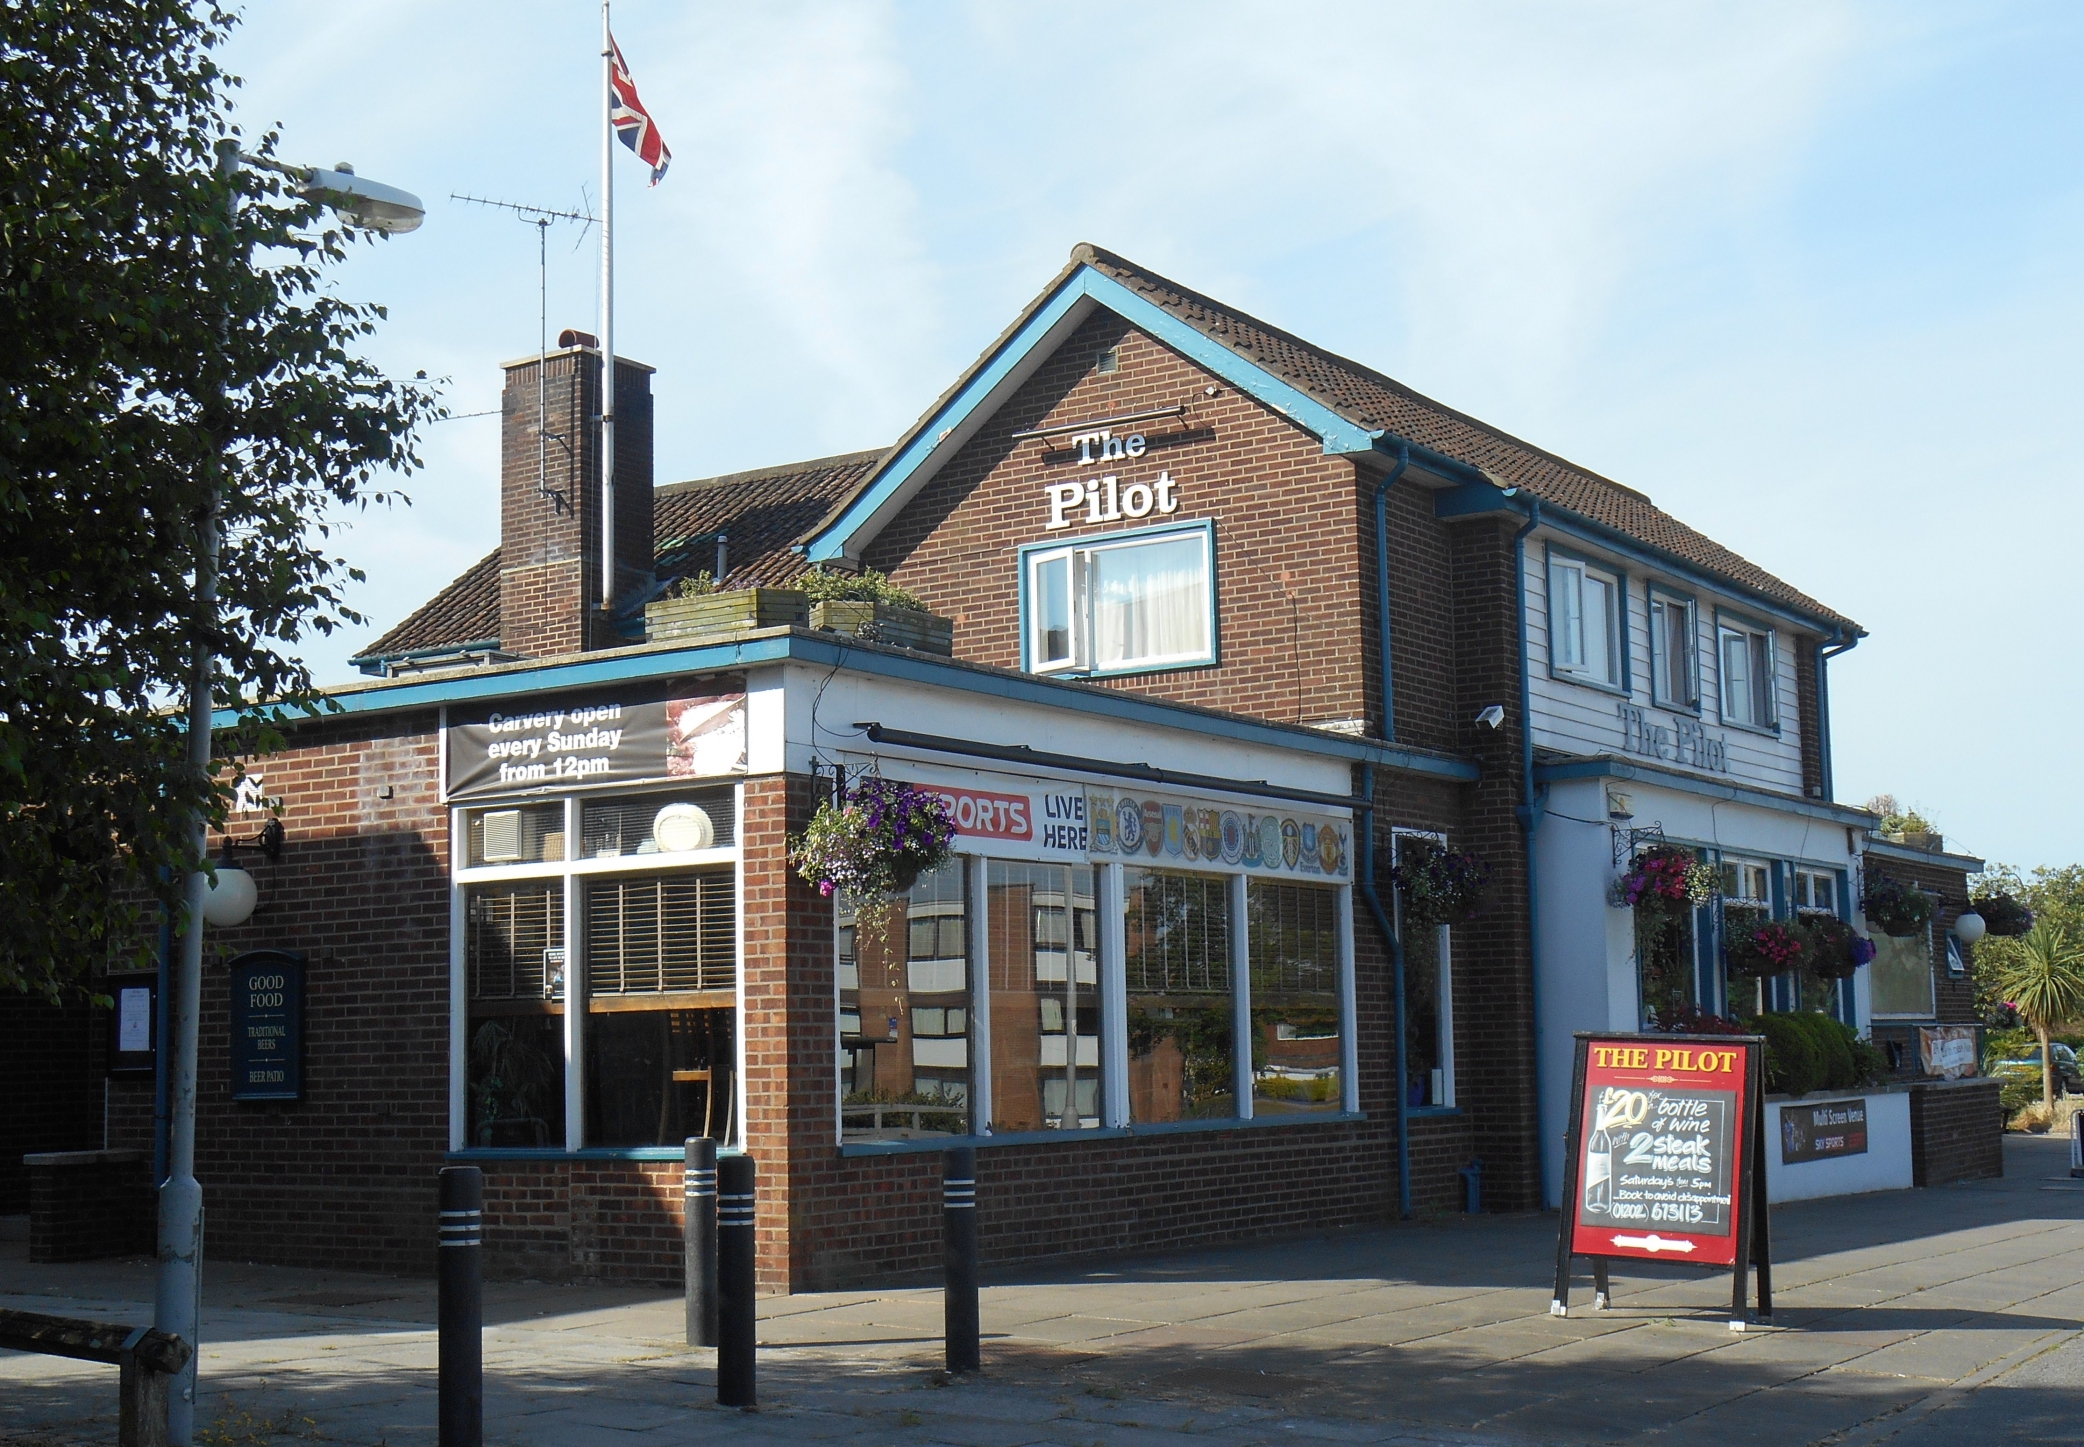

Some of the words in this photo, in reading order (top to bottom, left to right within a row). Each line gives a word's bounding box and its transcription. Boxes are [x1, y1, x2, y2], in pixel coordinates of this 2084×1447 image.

[1072, 430, 1146, 465] The
[1044, 471, 1178, 530] Pilot
[488, 709, 564, 733] Carvery
[571, 703, 621, 725] open
[488, 738, 542, 758] every
[547, 727, 622, 751] Sunday
[1617, 703, 1669, 759] The
[1673, 716, 1731, 772] Pilot
[499, 763, 546, 782] from
[552, 756, 610, 780] 12pm
[924, 792, 1028, 835] PORTS
[1045, 794, 1083, 821] LIVE
[1043, 824, 1088, 851] HERE
[248, 975, 284, 991] GOOD
[250, 992, 283, 1008] FOOD
[247, 1025, 286, 1038] TRADITIONAL
[257, 1039, 276, 1050] BEERS
[1594, 1047, 1649, 1069] THE
[1654, 1049, 1738, 1073] PILOT
[249, 1070, 266, 1083] BEER
[266, 1070, 285, 1082] PATIO
[1601, 1086, 1649, 1129] £20
[1657, 1097, 1708, 1117] bottle
[1813, 1109, 1829, 1127] Multi
[1828, 1109, 1848, 1125] Screen
[1847, 1107, 1865, 1123] Venue
[1651, 1117, 1668, 1133] of
[1669, 1117, 1711, 1133] wine
[1623, 1131, 1654, 1165] 2
[1653, 1133, 1712, 1157] steak
[1825, 1135, 1845, 1149] SPORTS
[1651, 1154, 1713, 1173] meals
[1643, 1190, 1653, 1200] to
[1653, 1191, 1678, 1202] avoid
[1651, 1202, 1704, 1224] 673113
